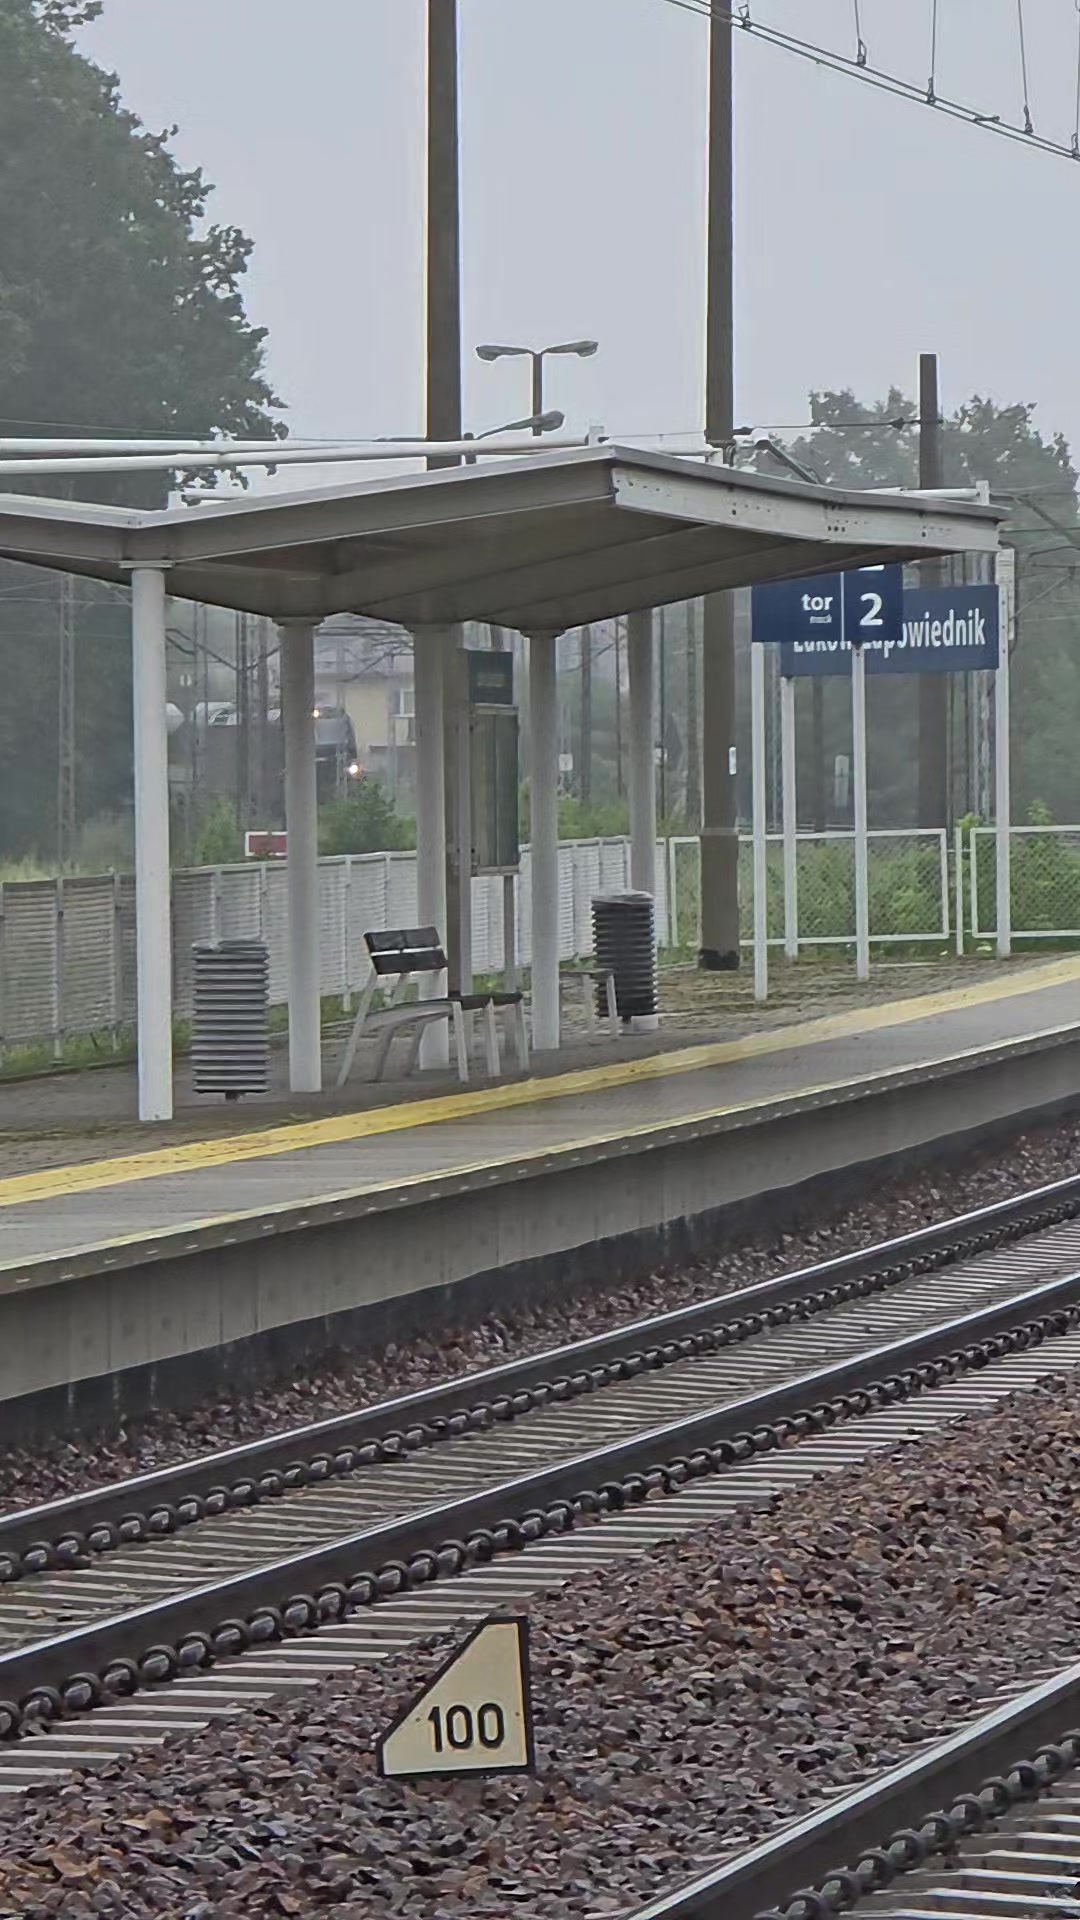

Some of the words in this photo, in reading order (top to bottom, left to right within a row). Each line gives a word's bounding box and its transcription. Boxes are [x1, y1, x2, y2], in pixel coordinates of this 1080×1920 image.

[801, 593, 833, 611] tor
[859, 592, 883, 626] 2
[427, 1702, 505, 1753] 100
